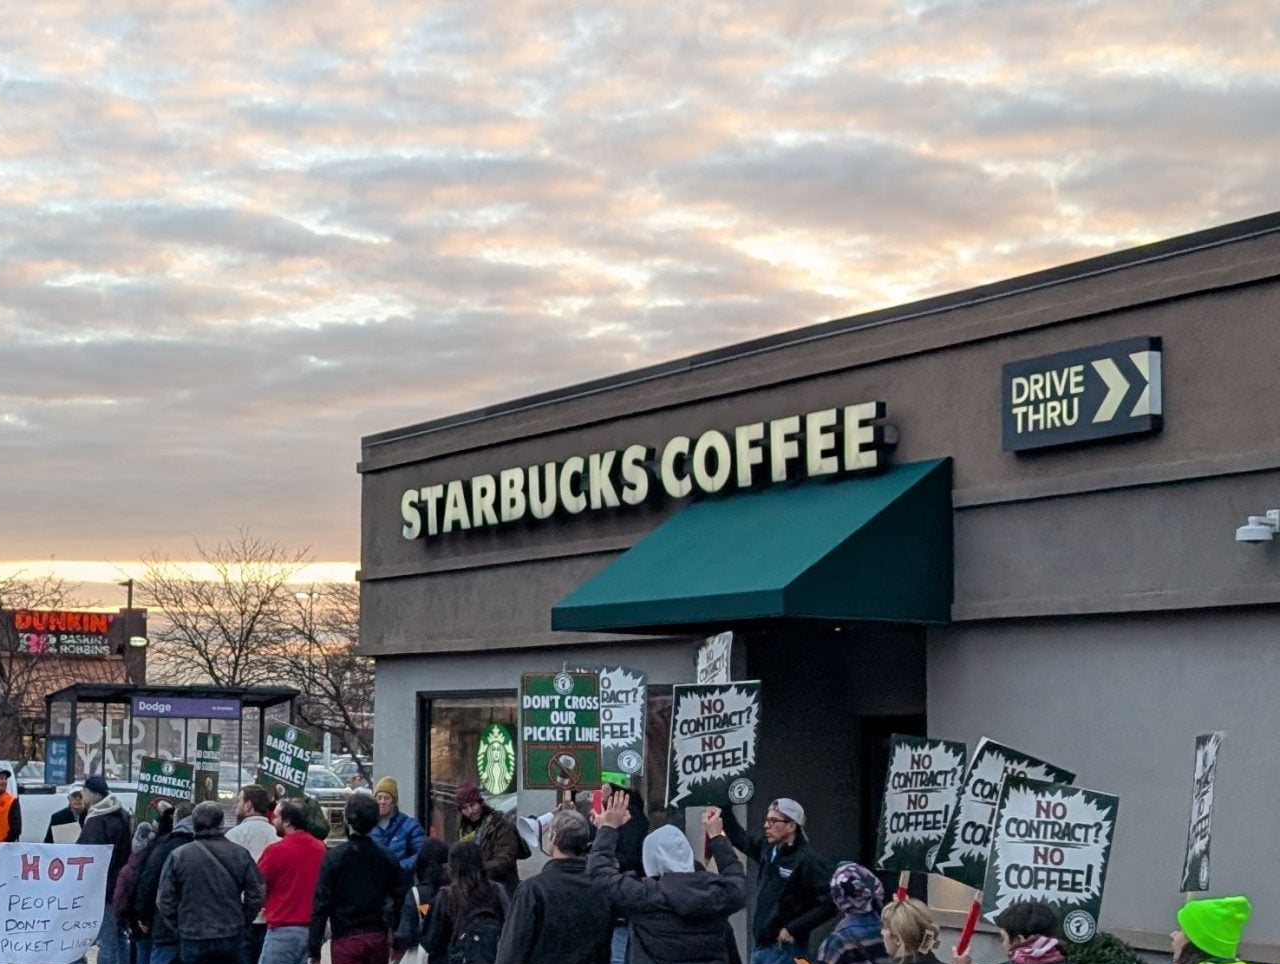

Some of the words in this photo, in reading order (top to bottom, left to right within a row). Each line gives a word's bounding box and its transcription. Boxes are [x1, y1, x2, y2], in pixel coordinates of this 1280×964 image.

[1011, 364, 1085, 405] DRIVE
[1011, 396, 1079, 434] THRU
[400, 444, 650, 540] STARBUCKS
[660, 401, 878, 498] COFFEE
[15, 611, 114, 632] DUNKIN'
[60, 645, 111, 655] ROBBINS
[601, 677, 611, 689] O
[523, 695, 560, 709] DON'T
[564, 695, 599, 710] CROSS
[601, 688, 638, 703] RACT?
[139, 701, 171, 713] Dodge
[602, 709, 613, 721] O
[700, 698, 724, 715] NO
[550, 711, 576, 724] OUR
[679, 706, 753, 735] CONTRACT?
[523, 726, 572, 741] PICKET
[575, 727, 600, 742] LINE
[601, 717, 635, 739] FEE!
[266, 735, 311, 761] BARISTAS
[701, 735, 725, 752] NO
[279, 752, 292, 765] ON
[682, 740, 748, 775] COFFEE!
[910, 754, 932, 770] NO
[261, 756, 307, 786] STRIKE!
[891, 767, 958, 790] CONTRACT?
[140, 772, 151, 781] NO
[152, 774, 192, 789] CONTRACT,
[137, 784, 149, 793] NO
[150, 785, 191, 800] STARBUCKS!
[907, 794, 929, 810] NO
[1035, 800, 1068, 820] NO
[889, 804, 950, 834] COFFEE!
[1004, 817, 1103, 844] CONTRACT?
[1032, 846, 1065, 866] NO
[21, 853, 94, 881] HOT
[1004, 863, 1094, 893] COFFEE!
[8, 894, 84, 911] PEOPLE
[5, 919, 51, 932] DON'T
[61, 920, 99, 931] CROSS
[0, 938, 54, 952] PICKET
